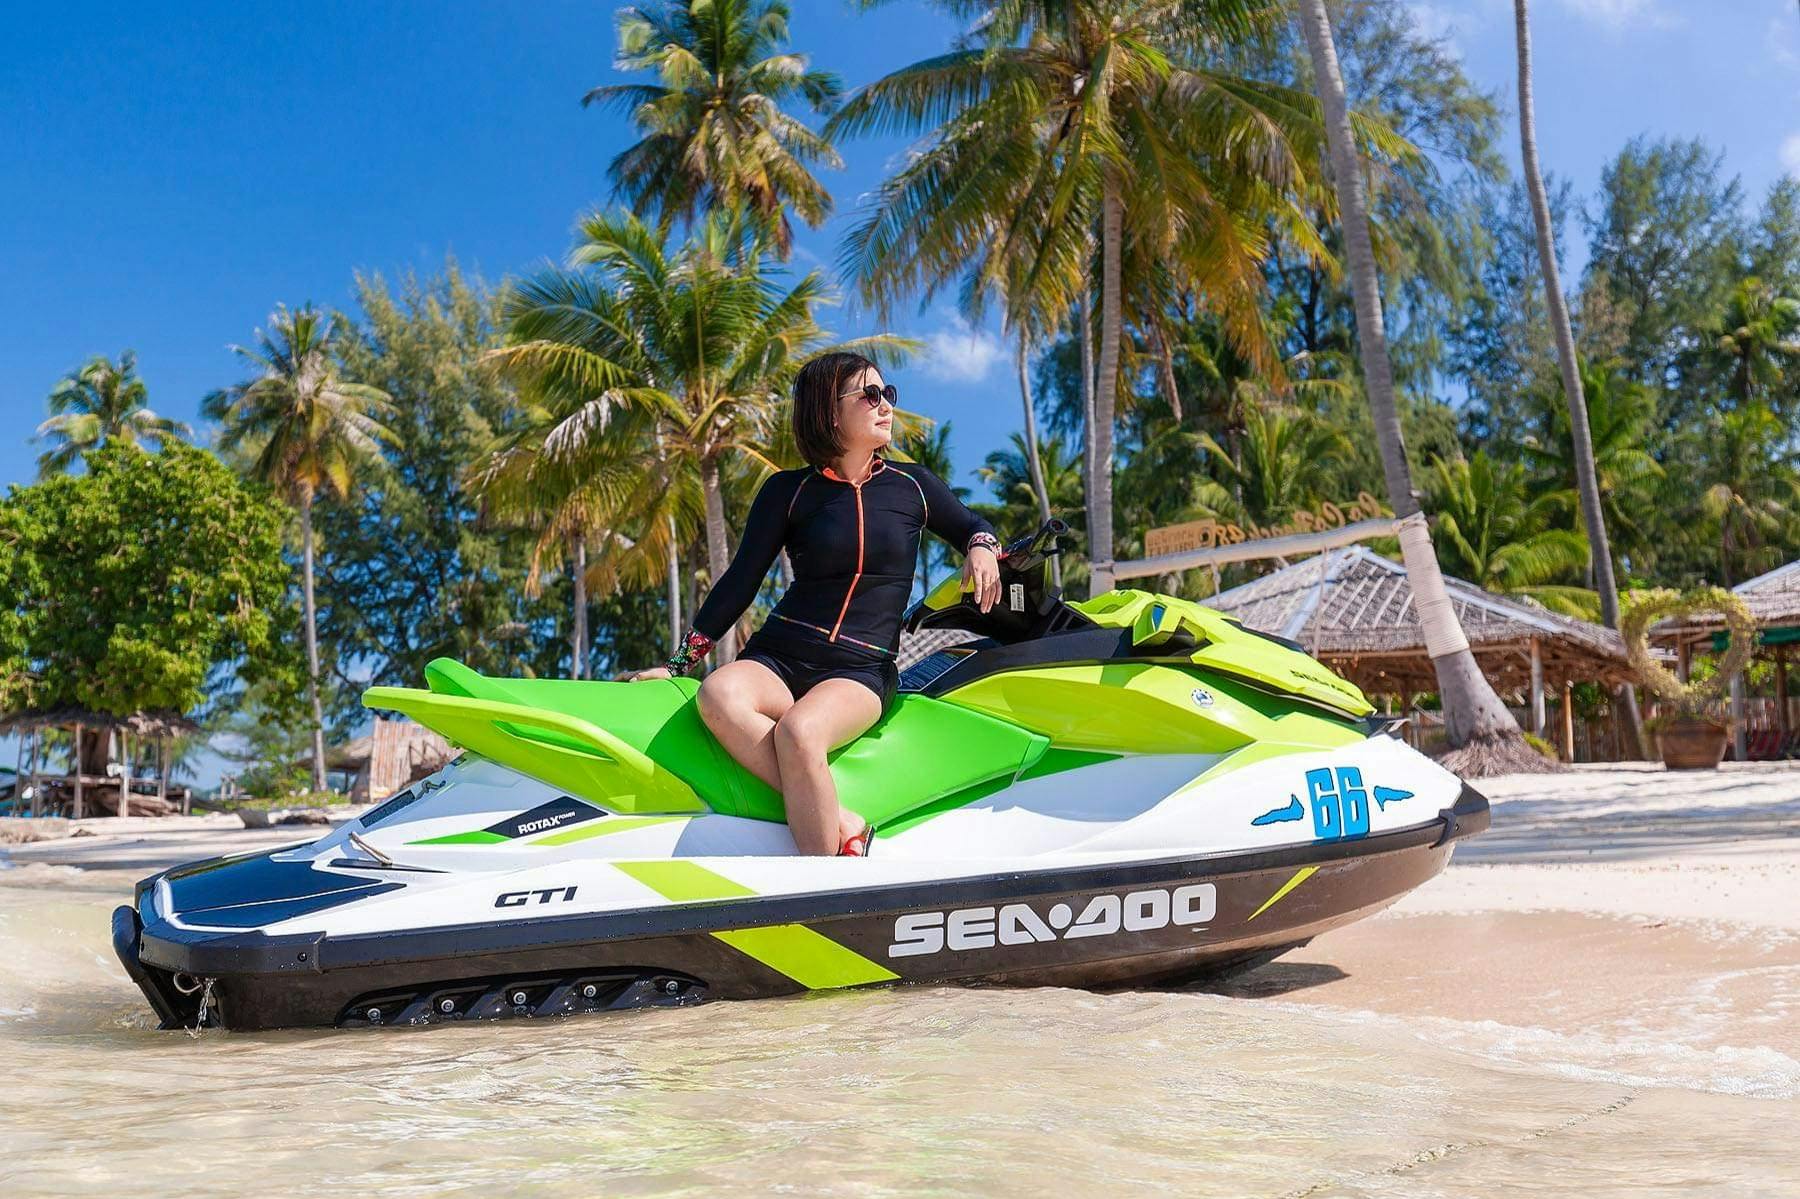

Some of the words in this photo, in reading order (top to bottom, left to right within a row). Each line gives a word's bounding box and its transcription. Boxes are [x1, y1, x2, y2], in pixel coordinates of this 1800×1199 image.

[1305, 766, 1370, 844] 66
[517, 815, 561, 835] ROTAX
[494, 886, 578, 908] GTI
